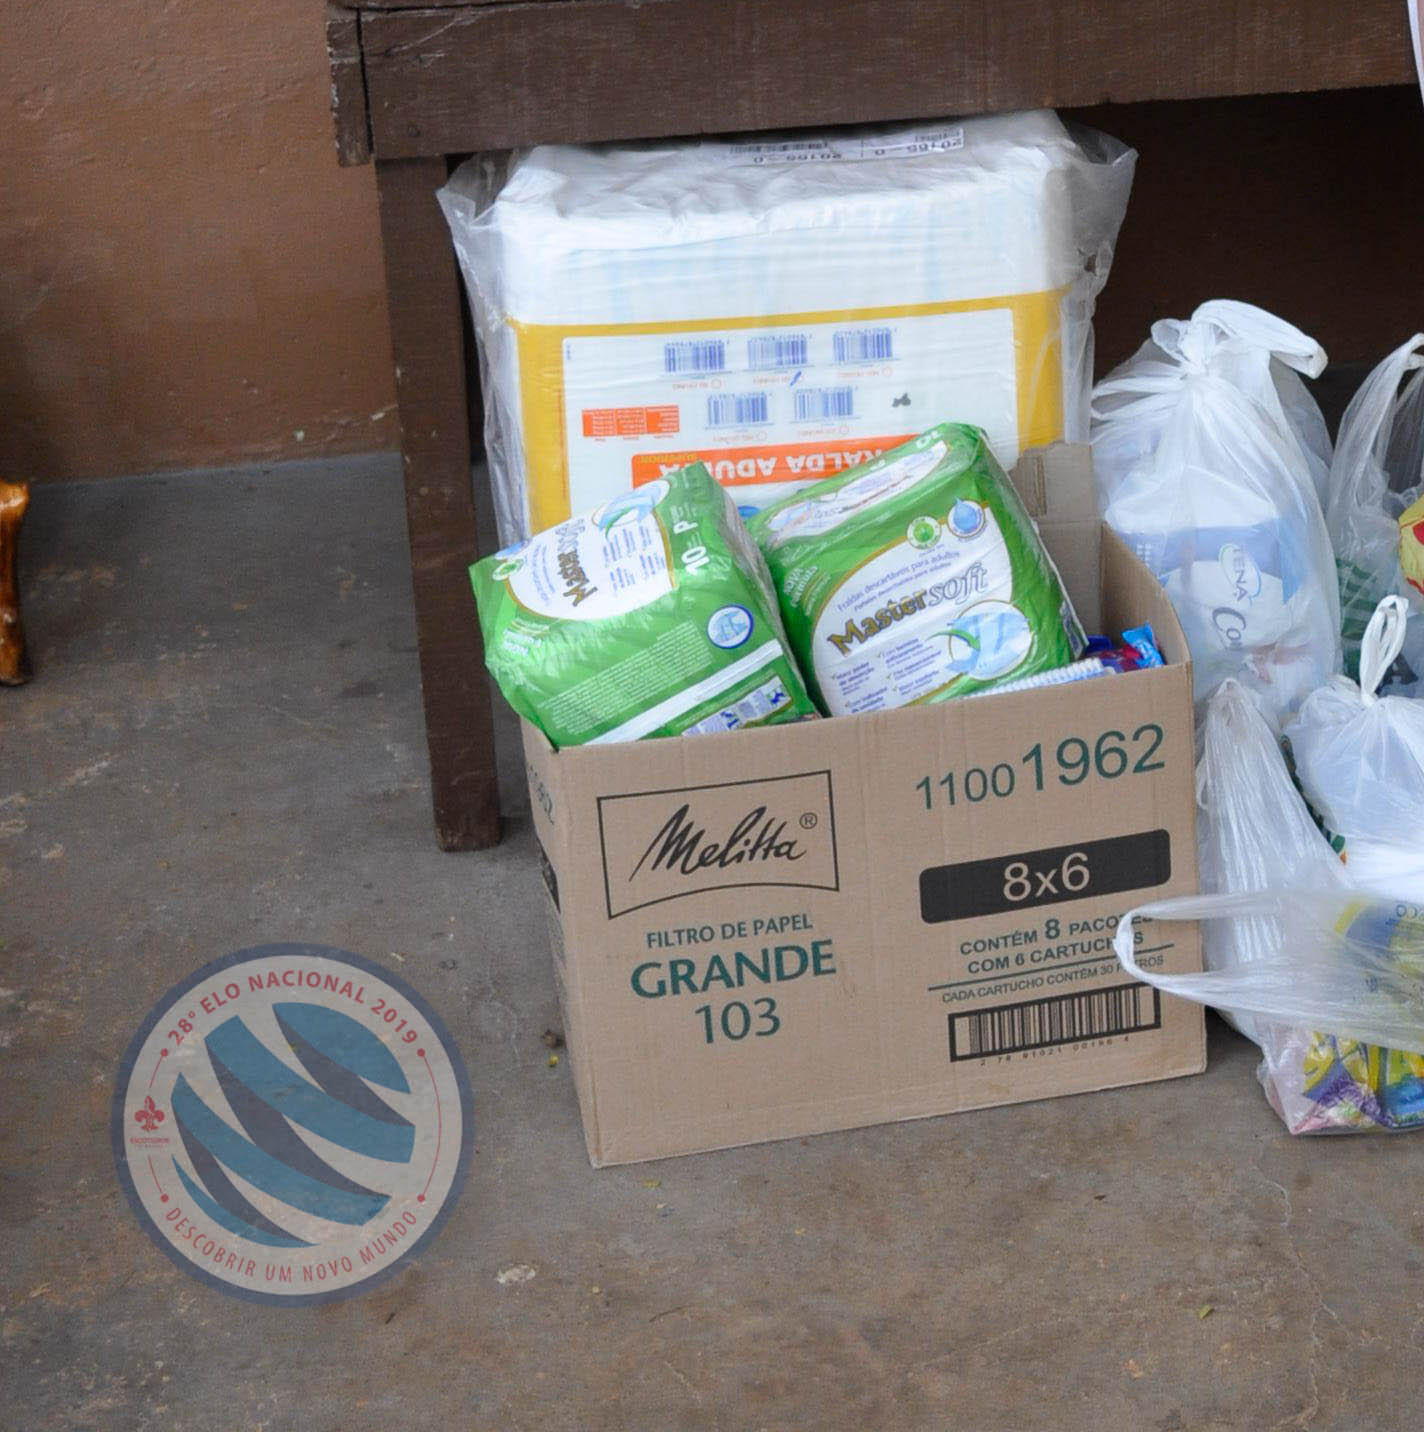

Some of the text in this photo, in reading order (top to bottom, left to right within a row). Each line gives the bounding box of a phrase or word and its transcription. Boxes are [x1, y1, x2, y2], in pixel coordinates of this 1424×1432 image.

[786, 447, 884, 473] RALDA
[628, 804, 808, 883] Melitta
[1001, 850, 1092, 903] 8x6
[646, 913, 814, 950] FILTRO DE PAPEL
[959, 928, 1038, 956] CONTÉM
[1044, 917, 1061, 940] 8
[967, 931, 1145, 975] COM 6 CARTUCHS
[630, 938, 838, 1001] GRANDE
[942, 989, 975, 1004] CADA
[976, 977, 1044, 997] CARTUCHO
[1046, 967, 1098, 985] CONTÉM
[694, 997, 782, 1045] 103
